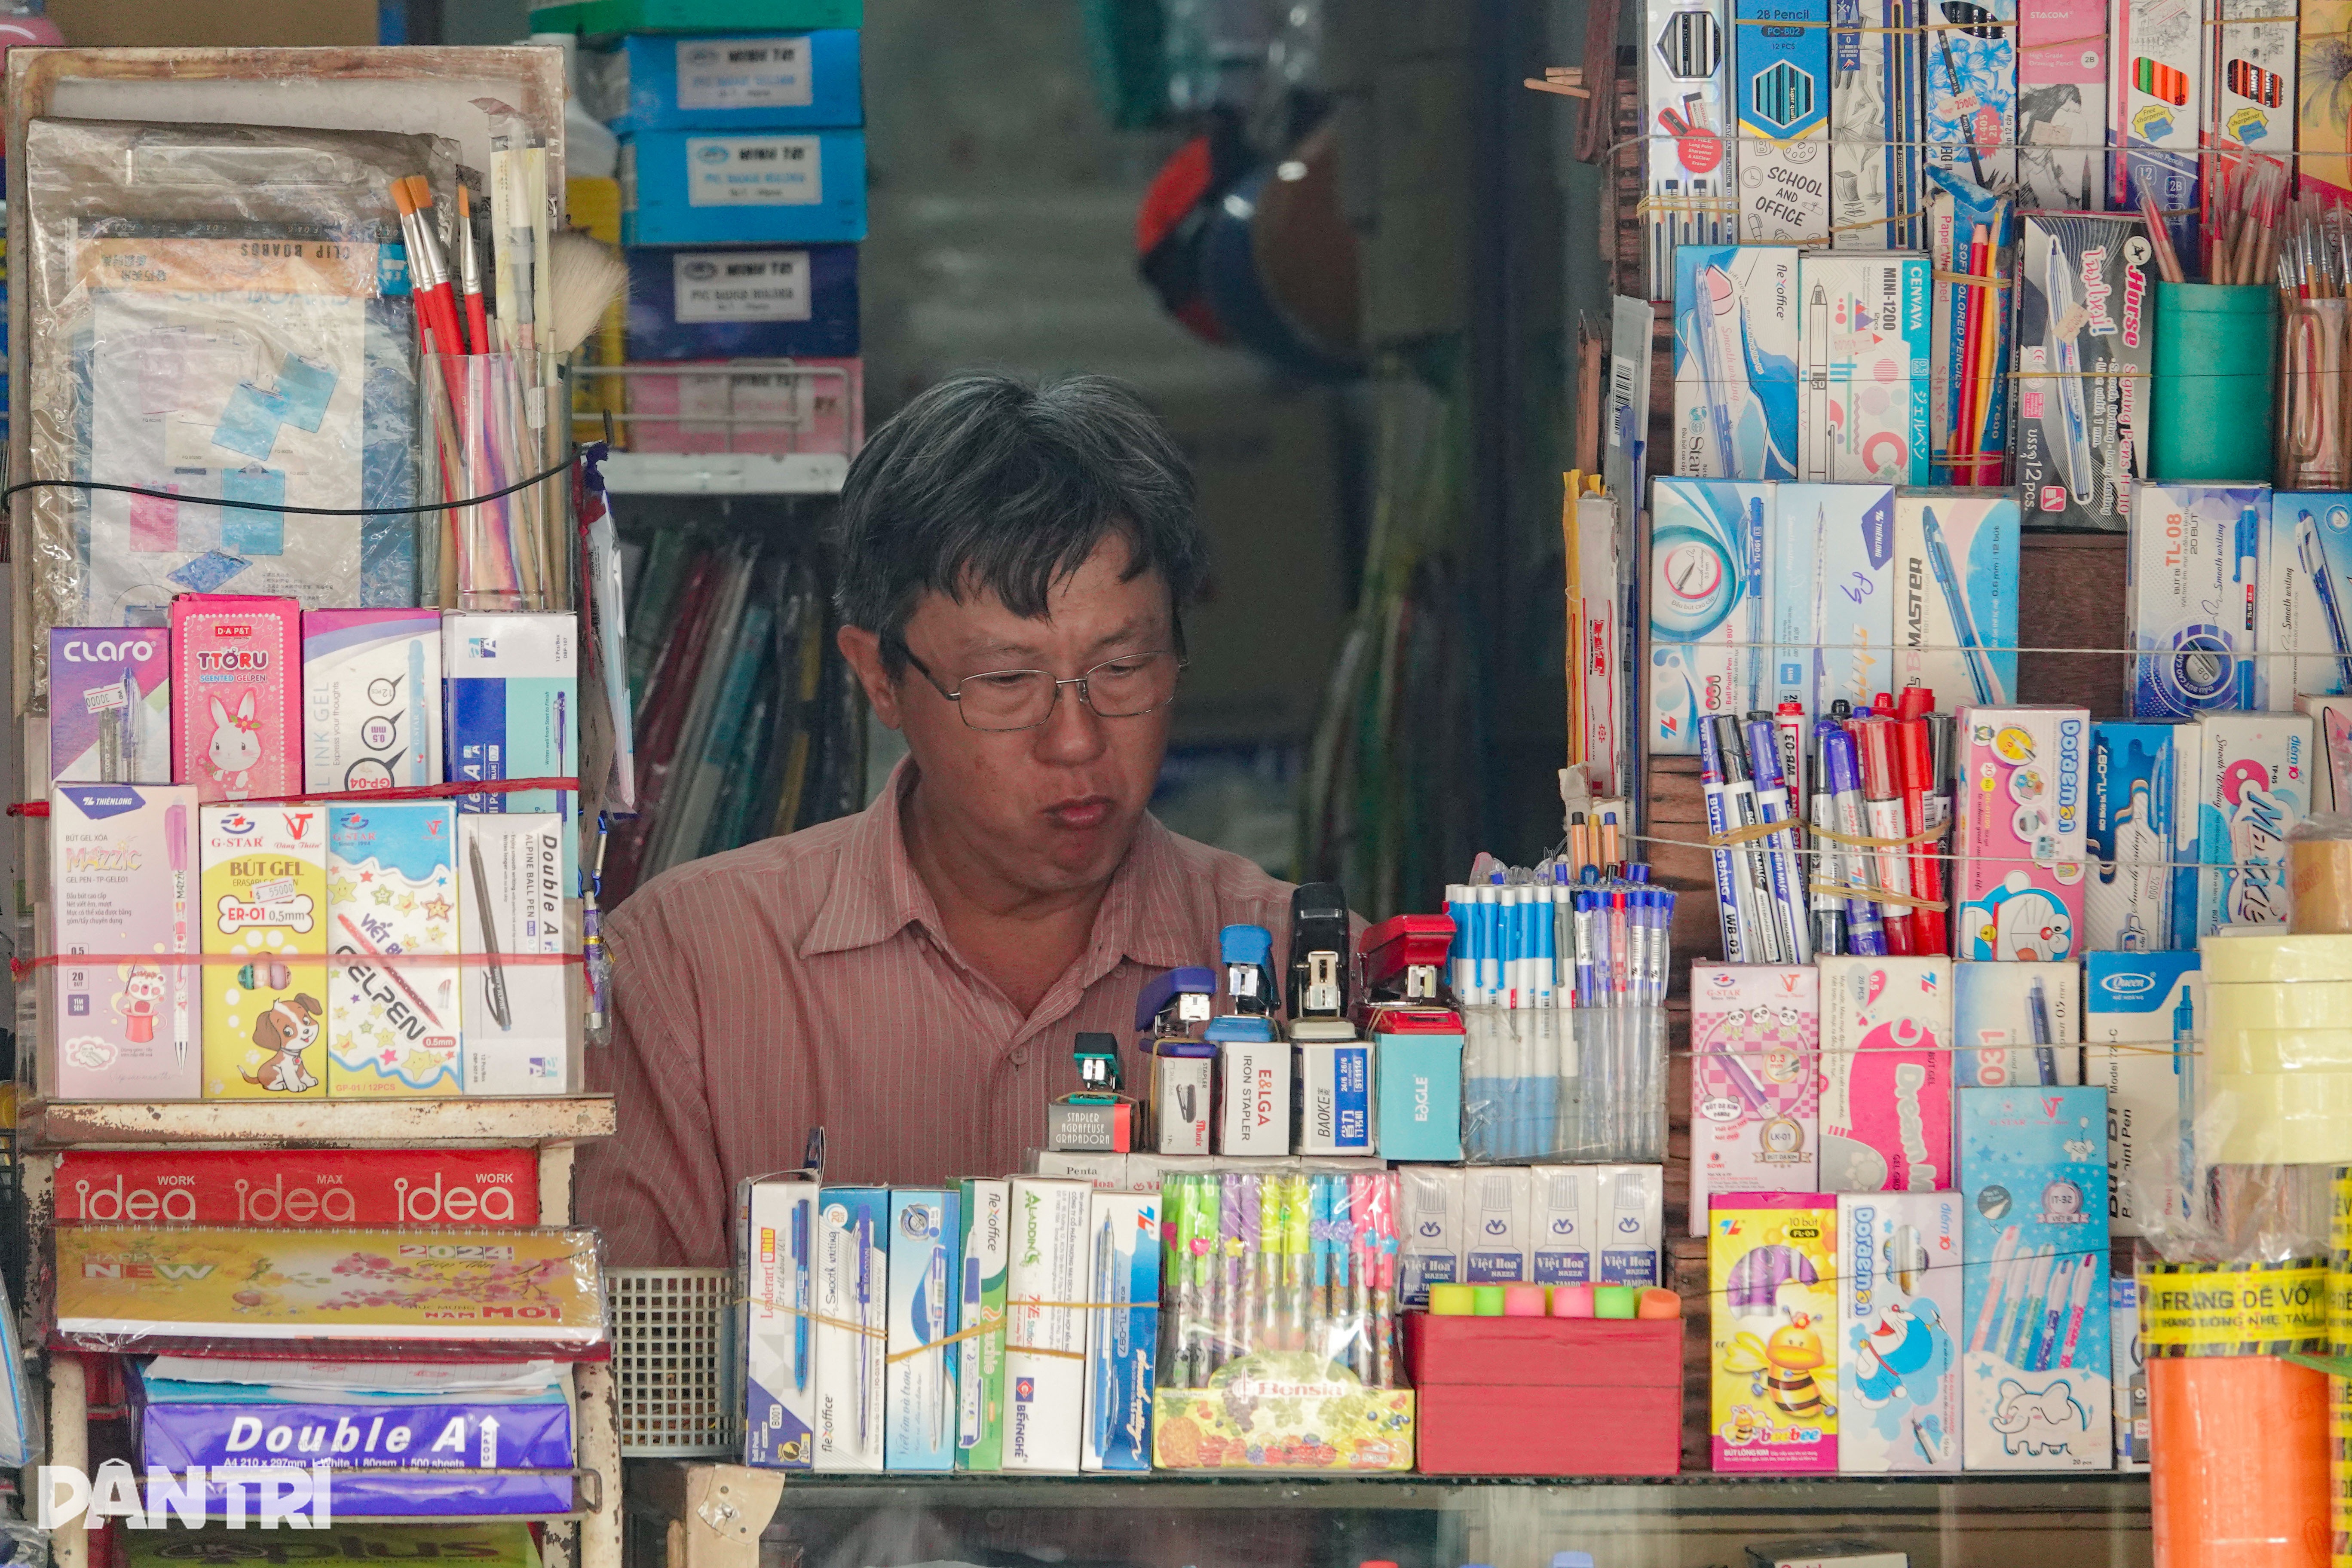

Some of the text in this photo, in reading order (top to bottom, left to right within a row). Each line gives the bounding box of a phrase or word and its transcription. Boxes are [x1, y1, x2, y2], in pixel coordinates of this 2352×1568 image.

[1757, 9, 1809, 19] 2B Pencil
[1767, 27, 1801, 36] PC-B02
[2006, 114, 2015, 137] 12 cây
[2137, 110, 2166, 122] sharpener
[1989, 124, 1997, 138] 2B
[1767, 166, 1822, 197] SCHOOL
[1776, 188, 1798, 202] AND
[1755, 196, 1806, 227] OFFICE
[1941, 216, 1953, 248] Paper
[241, 244, 303, 257] BOARDS
[1883, 267, 1896, 331] MINI-1200
[1910, 267, 1922, 330] CENVAVA
[2124, 265, 2145, 346] Horse
[2119, 365, 2137, 428] Signing
[1912, 390, 1926, 459] ジェルペン
[1689, 436, 1705, 477] Star
[2119, 430, 2133, 469] Pens
[2166, 513, 2182, 567] TL-08
[2191, 539, 2198, 554] 20
[2214, 524, 2226, 591] Smooth writing
[2283, 567, 2294, 628] Smooth writing
[200, 674, 266, 682] SCENTED GELPEN
[313, 683, 330, 768] INK GEL
[1700, 723, 1711, 762] WB-03
[1786, 734, 1795, 775] WB-03
[2216, 735, 2227, 774] Smooth
[350, 778, 390, 790] GP-04
[2059, 719, 2081, 834] Doraemon
[2097, 745, 2108, 795] TL-097
[1708, 796, 1719, 824] BÚT
[1890, 809, 1899, 835] Super
[230, 859, 304, 876] BÚT GEL
[269, 884, 293, 897] 55000
[543, 835, 558, 934] Double A
[2148, 877, 2160, 900] 52000
[1725, 913, 1739, 956] WB-03
[72, 972, 83, 981] 20
[1870, 976, 1879, 991] 0.5
[2111, 977, 2145, 989] Queen
[426, 1038, 453, 1046] 0.5mm
[1980, 1030, 2006, 1085] 031
[2110, 1069, 2119, 1093] Model
[1241, 1055, 1252, 1141] IRON STAPLER
[1258, 1069, 1272, 1126] E&LGA
[1067, 1112, 1099, 1122] STAPLER
[1318, 1096, 1330, 1137] BAOKE
[1895, 1063, 1926, 1162] Dream
[1056, 1134, 1110, 1144] GRAPADORA
[1061, 1124, 1104, 1133] AGRAFEUSE
[157, 1176, 196, 1185] WORK
[317, 1175, 343, 1184] MAX
[476, 1173, 513, 1183] WORK
[1066, 1166, 1097, 1175] Penta
[76, 1174, 196, 1221] idea
[235, 1173, 355, 1221] idea
[394, 1172, 514, 1221] idea
[831, 1211, 840, 1223] 20
[1802, 1218, 1818, 1226] bút
[83, 1264, 218, 1280] NEW
[826, 1231, 840, 1305] Smooth writing
[1537, 1256, 1584, 1270] Việt Hoa
[1604, 1255, 1651, 1269] Việt Hoa
[1854, 1207, 1874, 1317] Doraemon
[760, 1268, 773, 1319] Leaderart
[772, 1408, 780, 1427] B001
[225, 1416, 466, 1454] Double A
[1761, 1424, 1819, 1442] beebee
